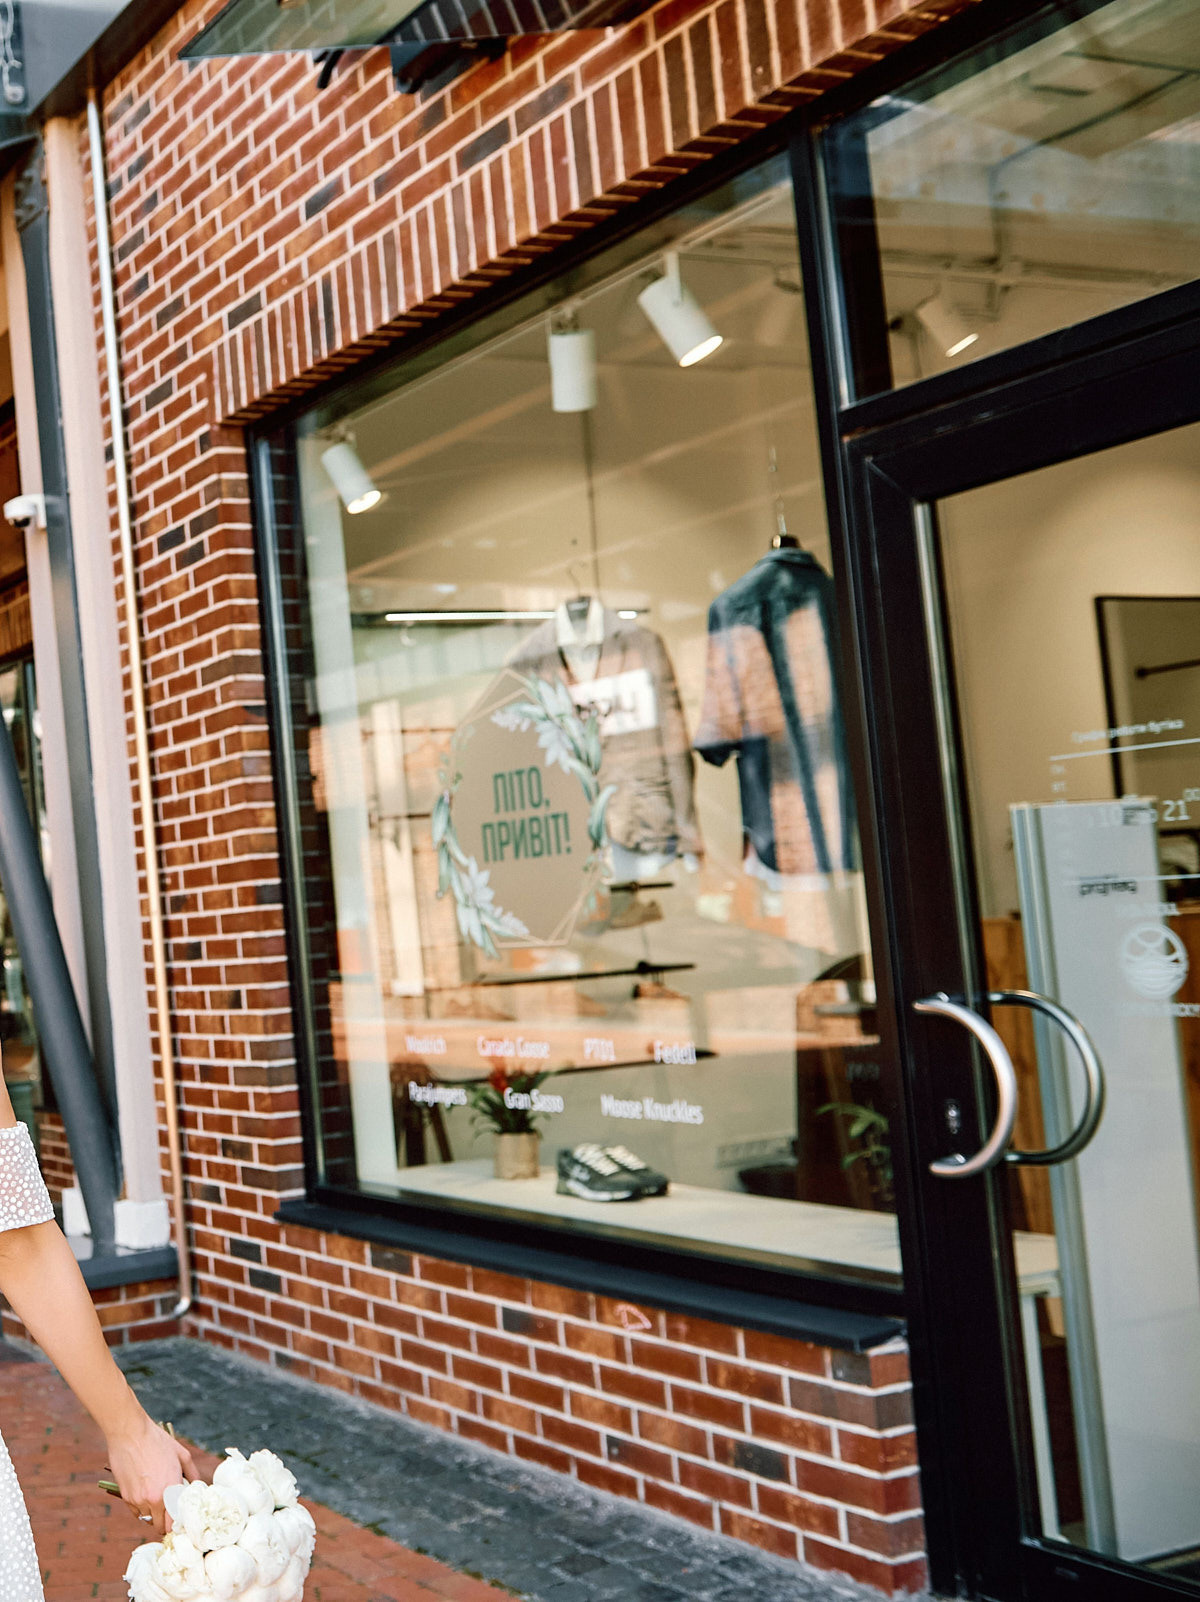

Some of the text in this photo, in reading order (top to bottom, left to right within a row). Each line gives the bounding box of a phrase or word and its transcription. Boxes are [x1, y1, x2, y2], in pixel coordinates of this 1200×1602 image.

[481, 811, 572, 863] ПРИВІТ!
[477, 1036, 550, 1059] Canada Goose
[408, 1080, 467, 1108] Parajumpers
[504, 1087, 531, 1110] Gran
[601, 1093, 704, 1125] Moose Knuckles
